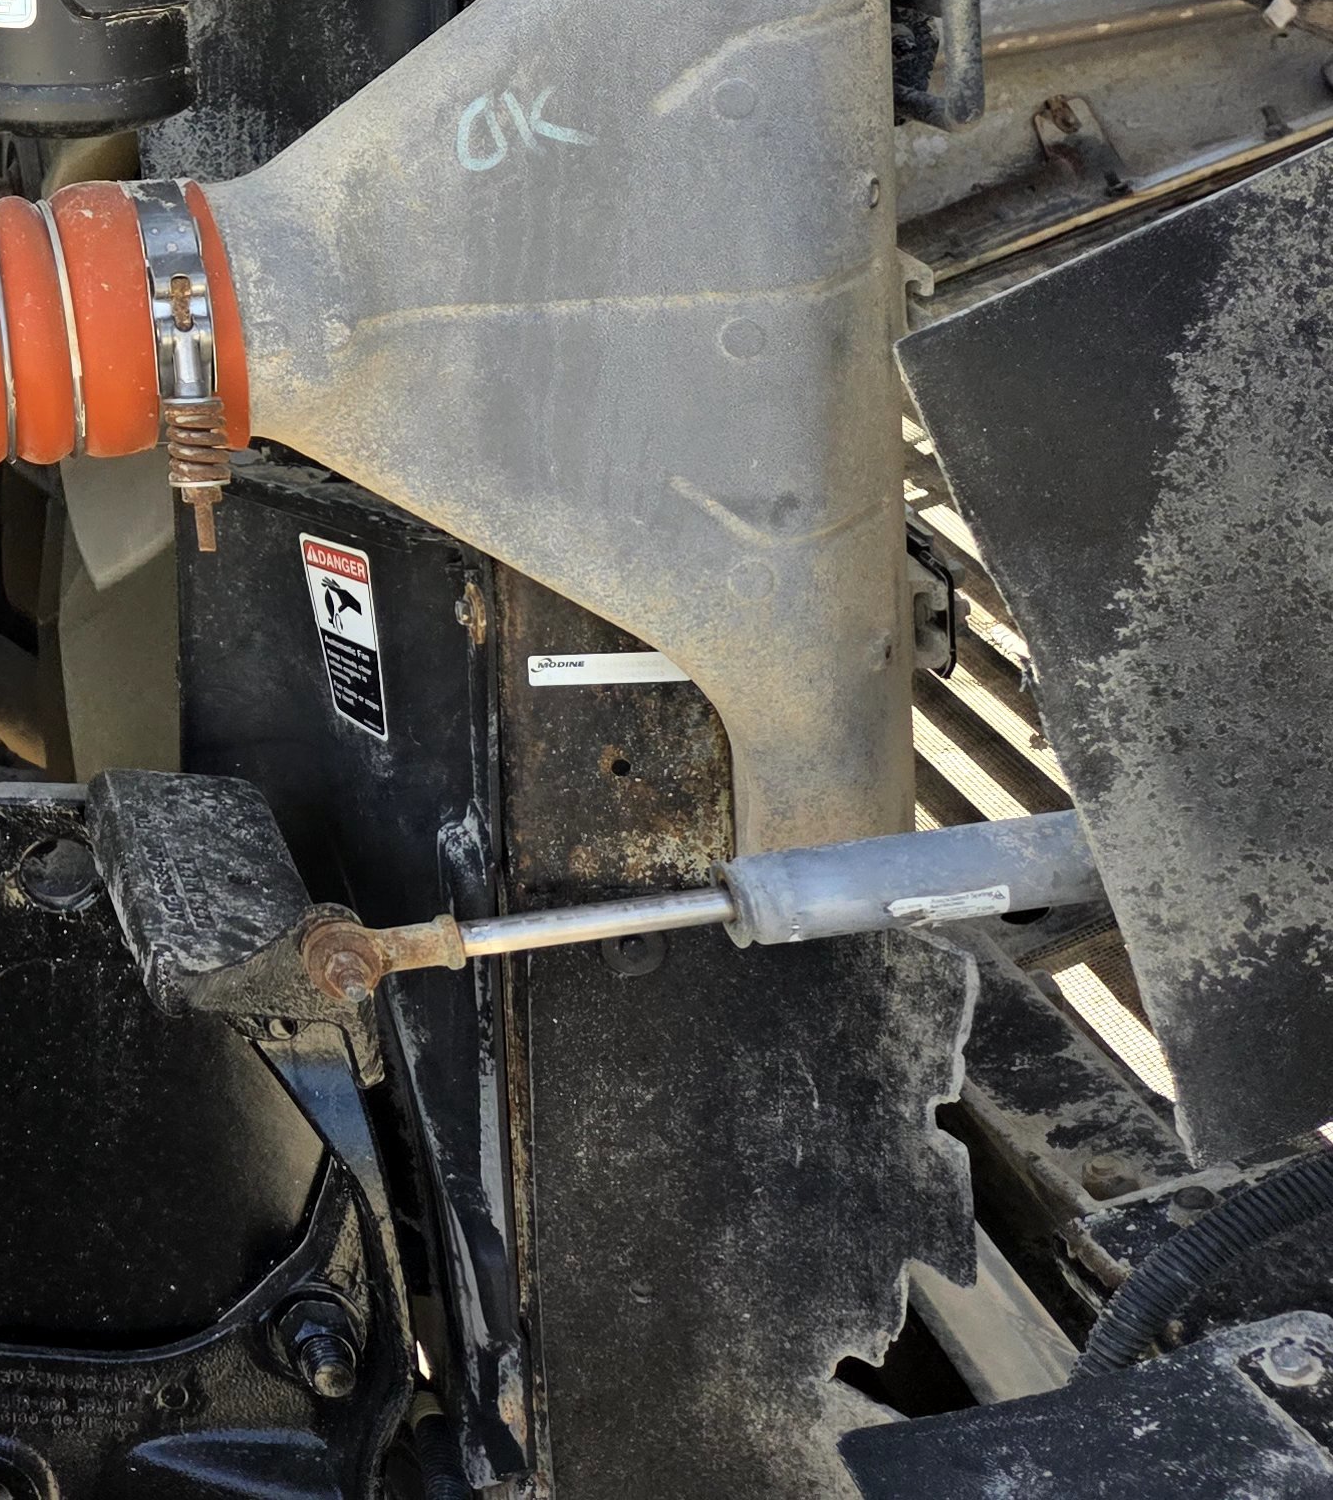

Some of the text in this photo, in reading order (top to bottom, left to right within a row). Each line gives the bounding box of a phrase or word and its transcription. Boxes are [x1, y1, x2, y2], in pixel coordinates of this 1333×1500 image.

[456, 85, 598, 172] OK
[317, 550, 366, 579] DANGER
[537, 660, 585, 669] MODINE
